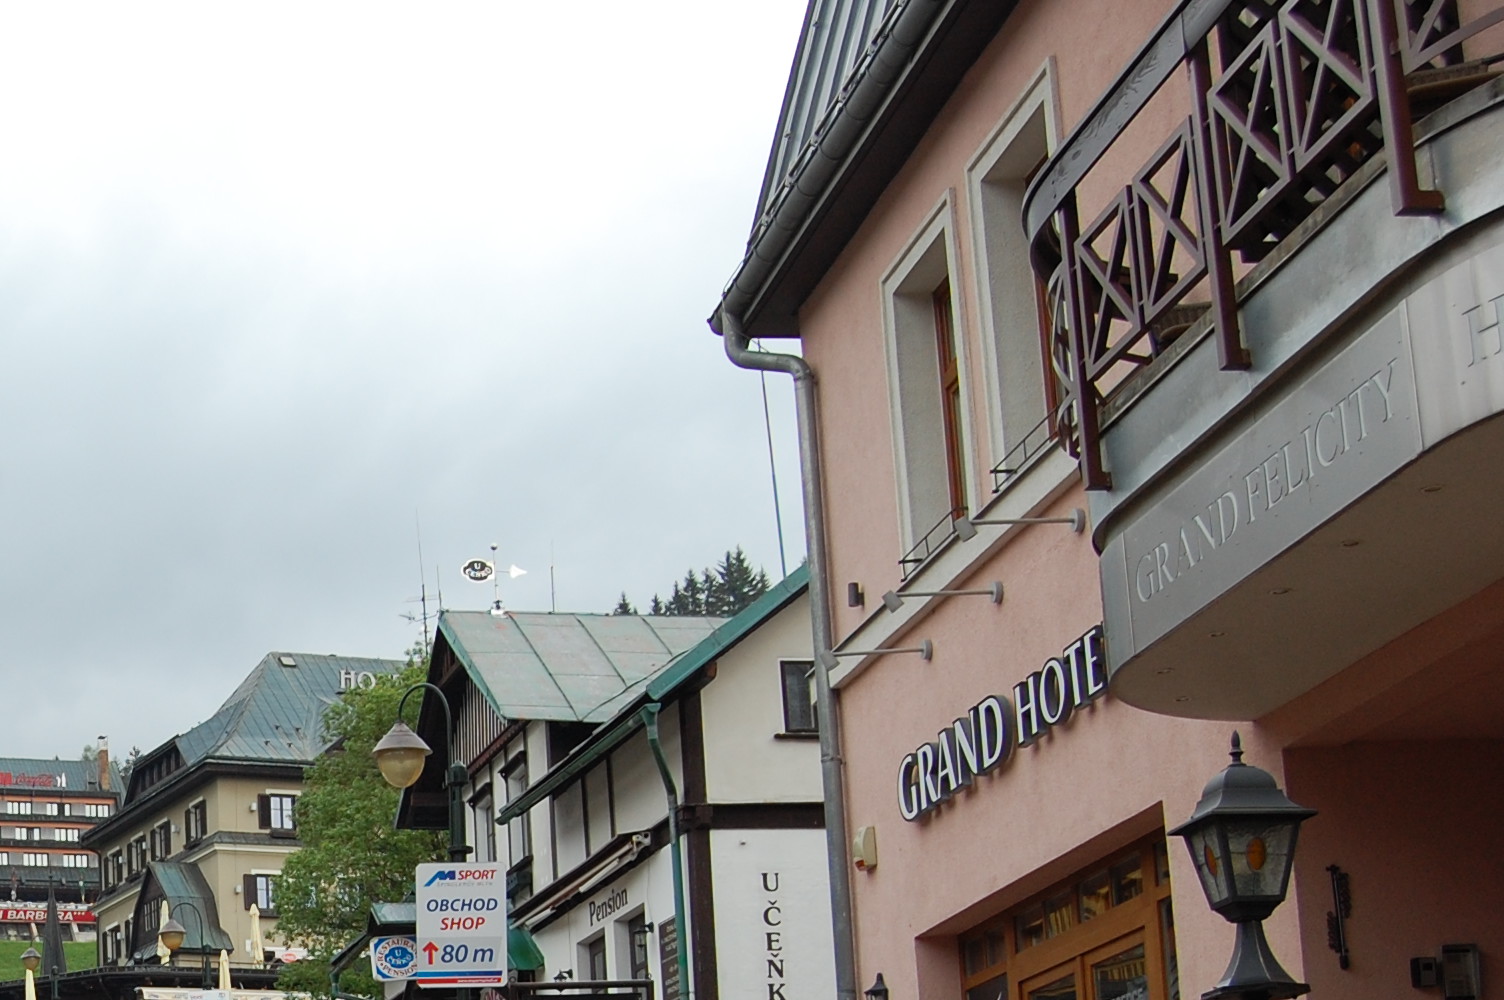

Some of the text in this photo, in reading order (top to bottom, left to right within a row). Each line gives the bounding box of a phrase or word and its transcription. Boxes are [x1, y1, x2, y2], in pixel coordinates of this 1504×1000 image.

[1135, 357, 1398, 603] GRAND FELICITY
[897, 627, 1105, 822] GRAND HOTE
[457, 869, 497, 881] SPORT
[426, 898, 498, 913] OBCHOD
[589, 887, 629, 928] Pension
[7, 910, 74, 921] BARBRA
[440, 917, 485, 931] SHOP
[441, 944, 494, 963] 80 m
